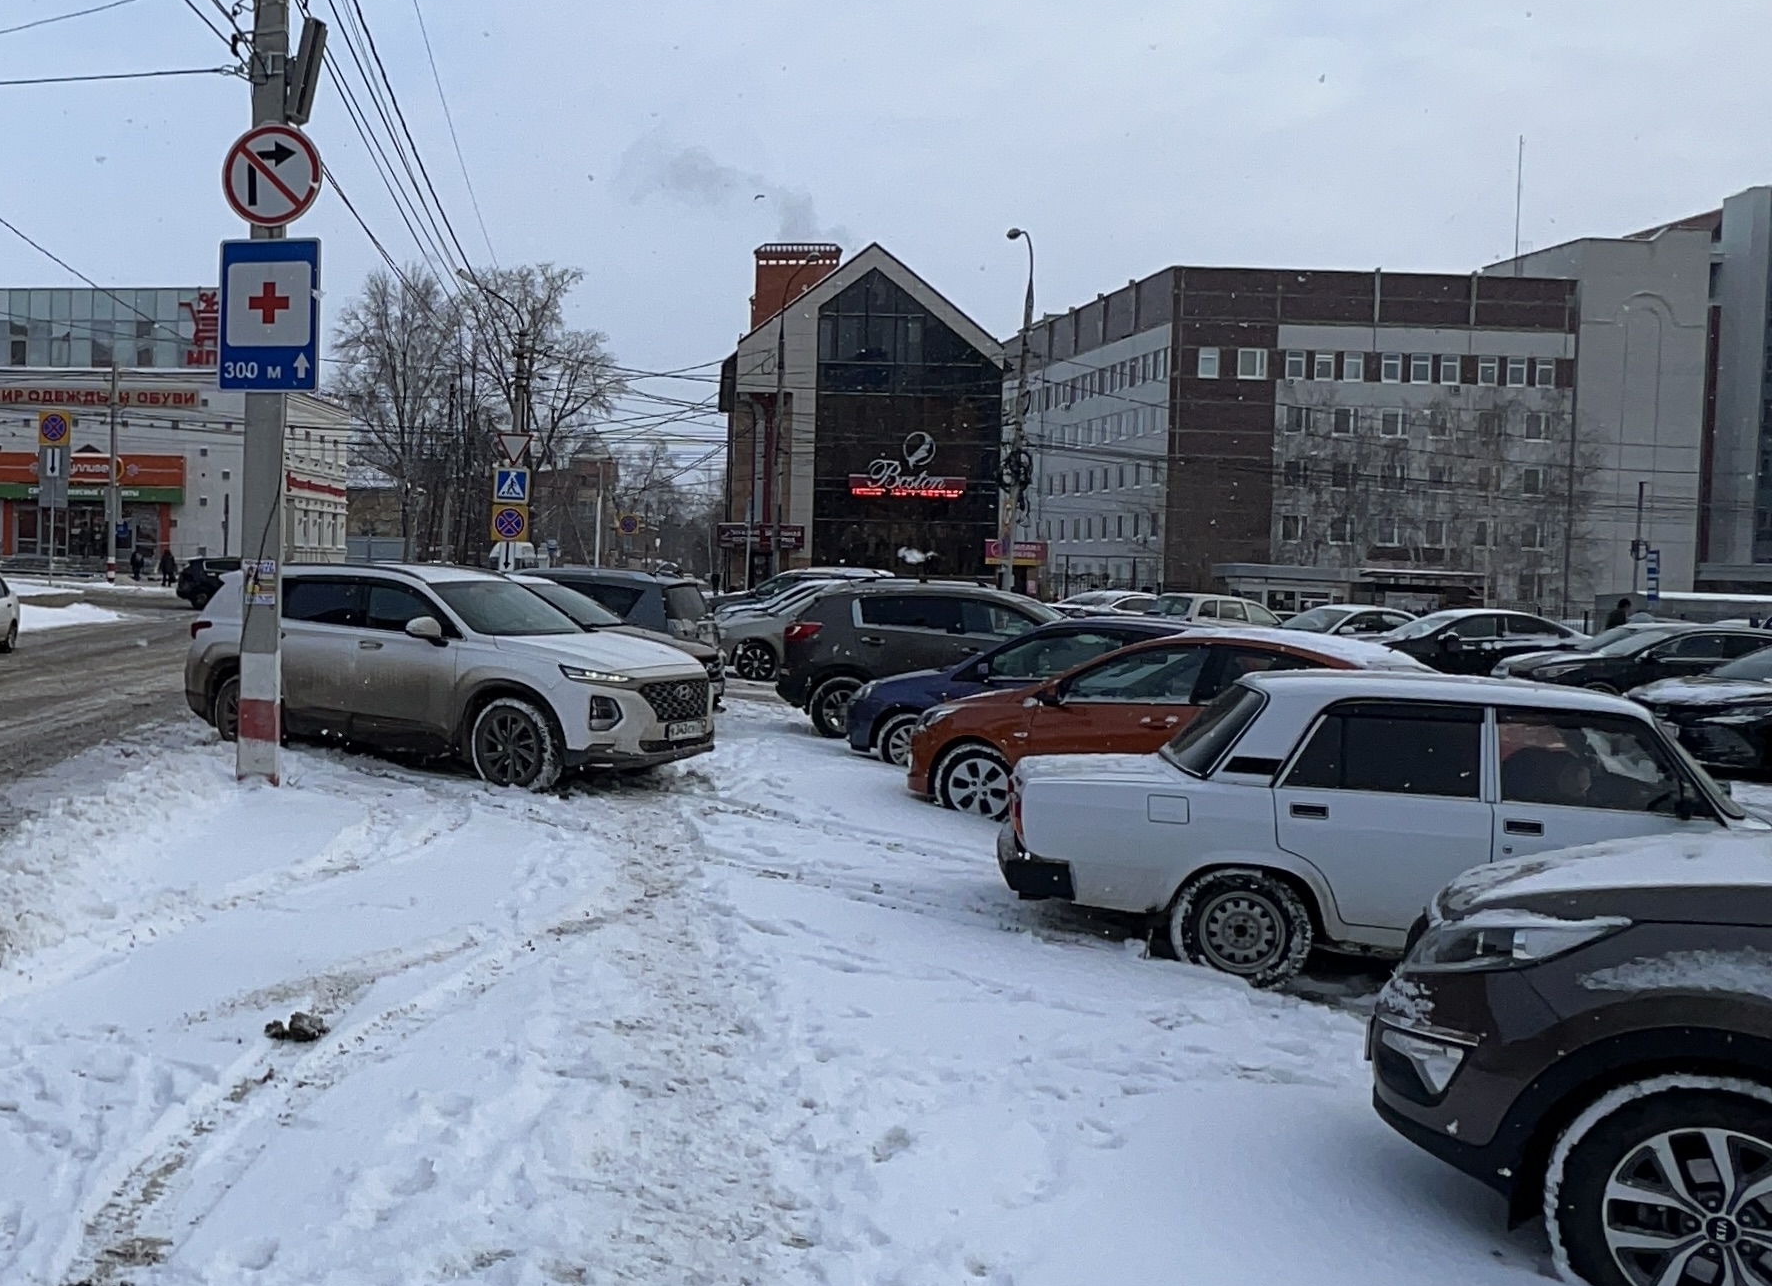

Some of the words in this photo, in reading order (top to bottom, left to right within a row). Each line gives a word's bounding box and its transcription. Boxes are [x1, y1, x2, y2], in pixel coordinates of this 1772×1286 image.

[224, 362, 258, 378] 300
[137, 391, 195, 405] ОБУВИ
[869, 459, 946, 489] Boston
